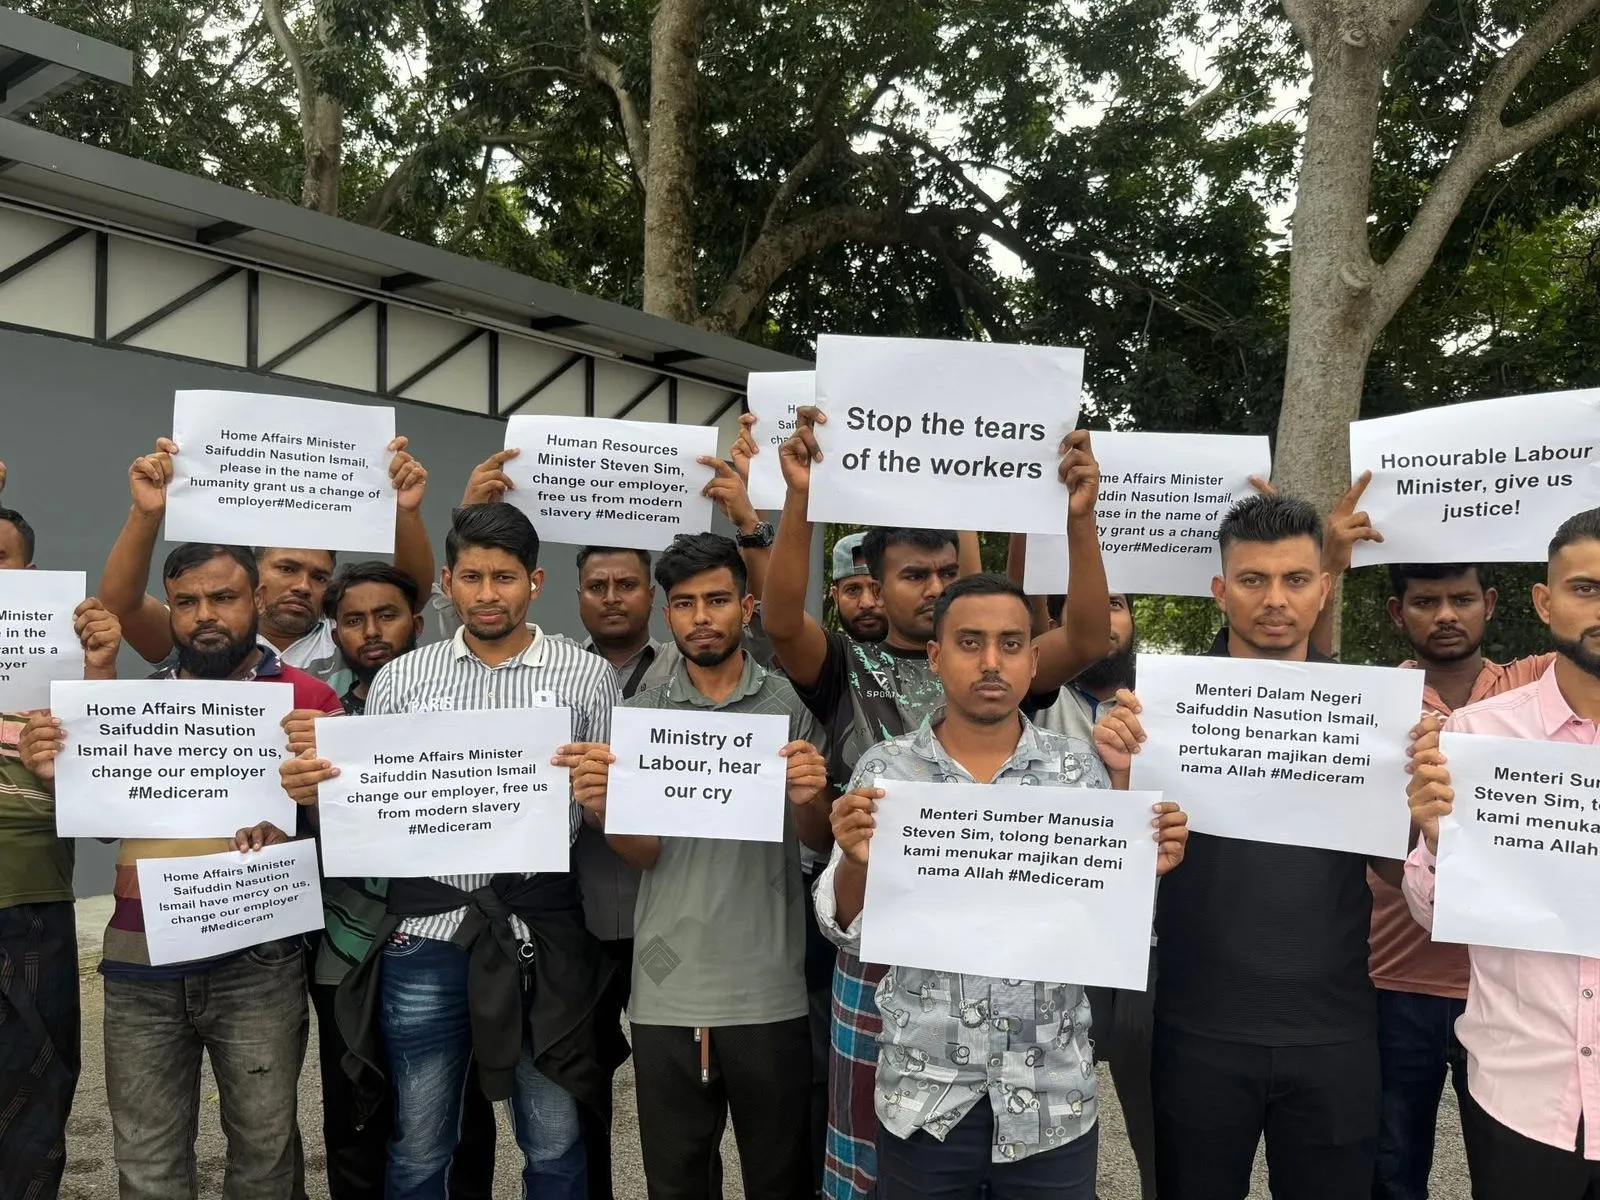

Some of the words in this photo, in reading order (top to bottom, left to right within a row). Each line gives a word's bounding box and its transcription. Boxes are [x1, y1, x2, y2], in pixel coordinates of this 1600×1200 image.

[847, 406, 912, 438] Stop
[921, 412, 965, 436] the
[974, 416, 1045, 441] tears
[221, 429, 257, 441] Home
[261, 432, 302, 445] Affairs
[307, 436, 356, 451] Minister
[547, 434, 597, 449] Human
[602, 439, 678, 456] Resources
[205, 444, 266, 459] Saifuddin
[270, 449, 325, 463] Nasution
[329, 454, 368, 469] Ismail,
[538, 452, 596, 469] Minister
[600, 458, 649, 473] Steven
[654, 462, 684, 478] Sim,
[842, 448, 871, 471] of
[878, 449, 921, 473] the
[930, 455, 1042, 479] workers
[1381, 448, 1507, 469] Honourable
[1514, 445, 1593, 463] Labour
[220, 462, 261, 474] please
[265, 465, 276, 475] in
[280, 466, 300, 477] the
[304, 470, 338, 480] name
[341, 472, 354, 482] of
[1122, 472, 1166, 485] Affairs
[1170, 473, 1224, 486] Minister
[190, 476, 250, 491] humanity
[253, 482, 286, 492] grant
[290, 485, 305, 493] us
[309, 486, 316, 494] a
[319, 486, 365, 499] change
[368, 489, 381, 499] of
[532, 472, 586, 489] change
[590, 479, 615, 488] our
[618, 480, 688, 494] employer,
[1397, 478, 1487, 495] Minister,
[1495, 474, 1539, 494] give
[1547, 474, 1573, 487] us
[218, 496, 352, 512] employer#Mediceram
[537, 490, 566, 502] free
[570, 494, 587, 503] us
[591, 493, 625, 504] from
[629, 496, 682, 508] modern
[1131, 491, 1189, 503] Nasution
[540, 507, 592, 521] slavery
[595, 509, 680, 524] #Mediceram
[1125, 508, 1137, 519] in
[1141, 509, 1161, 520] the
[1165, 512, 1201, 521] name
[1205, 510, 1219, 521] of
[1441, 499, 1520, 523] justice!
[1110, 526, 1146, 538] grant
[1149, 528, 1165, 537] us
[1168, 529, 1177, 537] a
[0, 610, 54, 621] Minister
[6, 627, 19, 638] in
[24, 628, 46, 638] the
[29, 647, 46, 655] us
[50, 647, 58, 655] a
[411, 696, 453, 713] PARIS
[1196, 683, 1252, 698] Menteri
[1257, 686, 1305, 701] Dalam
[1310, 689, 1362, 706] Negeri
[87, 704, 136, 716] Home
[141, 702, 196, 715] Affairs
[202, 703, 266, 717] Minister
[1176, 702, 1248, 718] Saifuddin
[1253, 706, 1322, 722] Nasution
[1328, 711, 1378, 728] Ismail,
[99, 723, 179, 736] Saifuddin
[184, 723, 255, 737] Nasution
[650, 728, 727, 750] Ministry
[733, 733, 753, 748] of
[1192, 723, 1240, 740] tolong
[1246, 726, 1317, 742] benarkan
[1323, 731, 1359, 745] kami
[78, 744, 127, 756] Ismail
[134, 744, 173, 756] have
[178, 747, 228, 760] mercy
[233, 747, 253, 757] on
[259, 748, 281, 760] us,
[374, 754, 414, 765] Home
[419, 751, 464, 762] Affairs
[469, 749, 523, 760] Minister
[1179, 744, 1262, 759] pertukaran
[1267, 749, 1327, 764] majikan
[1332, 753, 1370, 766] demi
[91, 765, 152, 781] change
[158, 768, 186, 777] our
[190, 765, 266, 780] employer
[360, 770, 427, 784] Saifuddin
[432, 767, 492, 780] Nasution
[497, 763, 536, 776] Ismail
[639, 754, 711, 775] Labour,
[719, 757, 761, 774] hear
[1181, 764, 1222, 775] nama
[1226, 764, 1266, 778] Allah
[1270, 768, 1365, 785] #Mediceram
[1494, 766, 1563, 785] Menteri
[128, 786, 228, 799] #Mediceram
[347, 792, 399, 804] change
[404, 790, 427, 800] our
[431, 785, 498, 799] employer,
[502, 782, 528, 793] free
[533, 783, 548, 792] us
[664, 786, 697, 798] our
[702, 787, 732, 804] cry
[1474, 786, 1537, 805] Steven
[1544, 793, 1584, 812] Sim,
[377, 808, 410, 819] from
[415, 805, 467, 817] modern
[472, 802, 520, 813] slavery
[920, 808, 978, 821] Menteri
[983, 810, 1044, 824] Sumber
[1048, 812, 1114, 828] Manusia
[1476, 808, 1520, 825] kami
[408, 821, 491, 835] #Mediceram
[902, 825, 955, 839] Steven
[961, 828, 994, 843] Sim,
[999, 830, 1049, 846] tolong
[1054, 832, 1127, 849] benarkan
[1494, 835, 1544, 850] nama
[1550, 839, 1598, 856] Allah
[904, 844, 940, 857] kami
[945, 848, 1014, 861] menukar
[1018, 851, 1078, 866] majikan
[1083, 854, 1122, 870] demi
[163, 873, 199, 882] Home
[203, 868, 244, 879] Affairs
[247, 859, 296, 874] Minister
[918, 867, 960, 877] nama
[964, 866, 1004, 880] Allah
[1008, 869, 1104, 890] #Mediceram
[173, 883, 232, 896] Saifuddin
[235, 872, 290, 889] Nasution
[159, 900, 196, 911] Ismail
[199, 897, 229, 908] have
[232, 888, 269, 903] mercy
[273, 884, 289, 893] on
[171, 913, 216, 925] change
[219, 907, 240, 917] our
[243, 894, 299, 912] employer
[200, 913, 274, 934] #Mediceram
